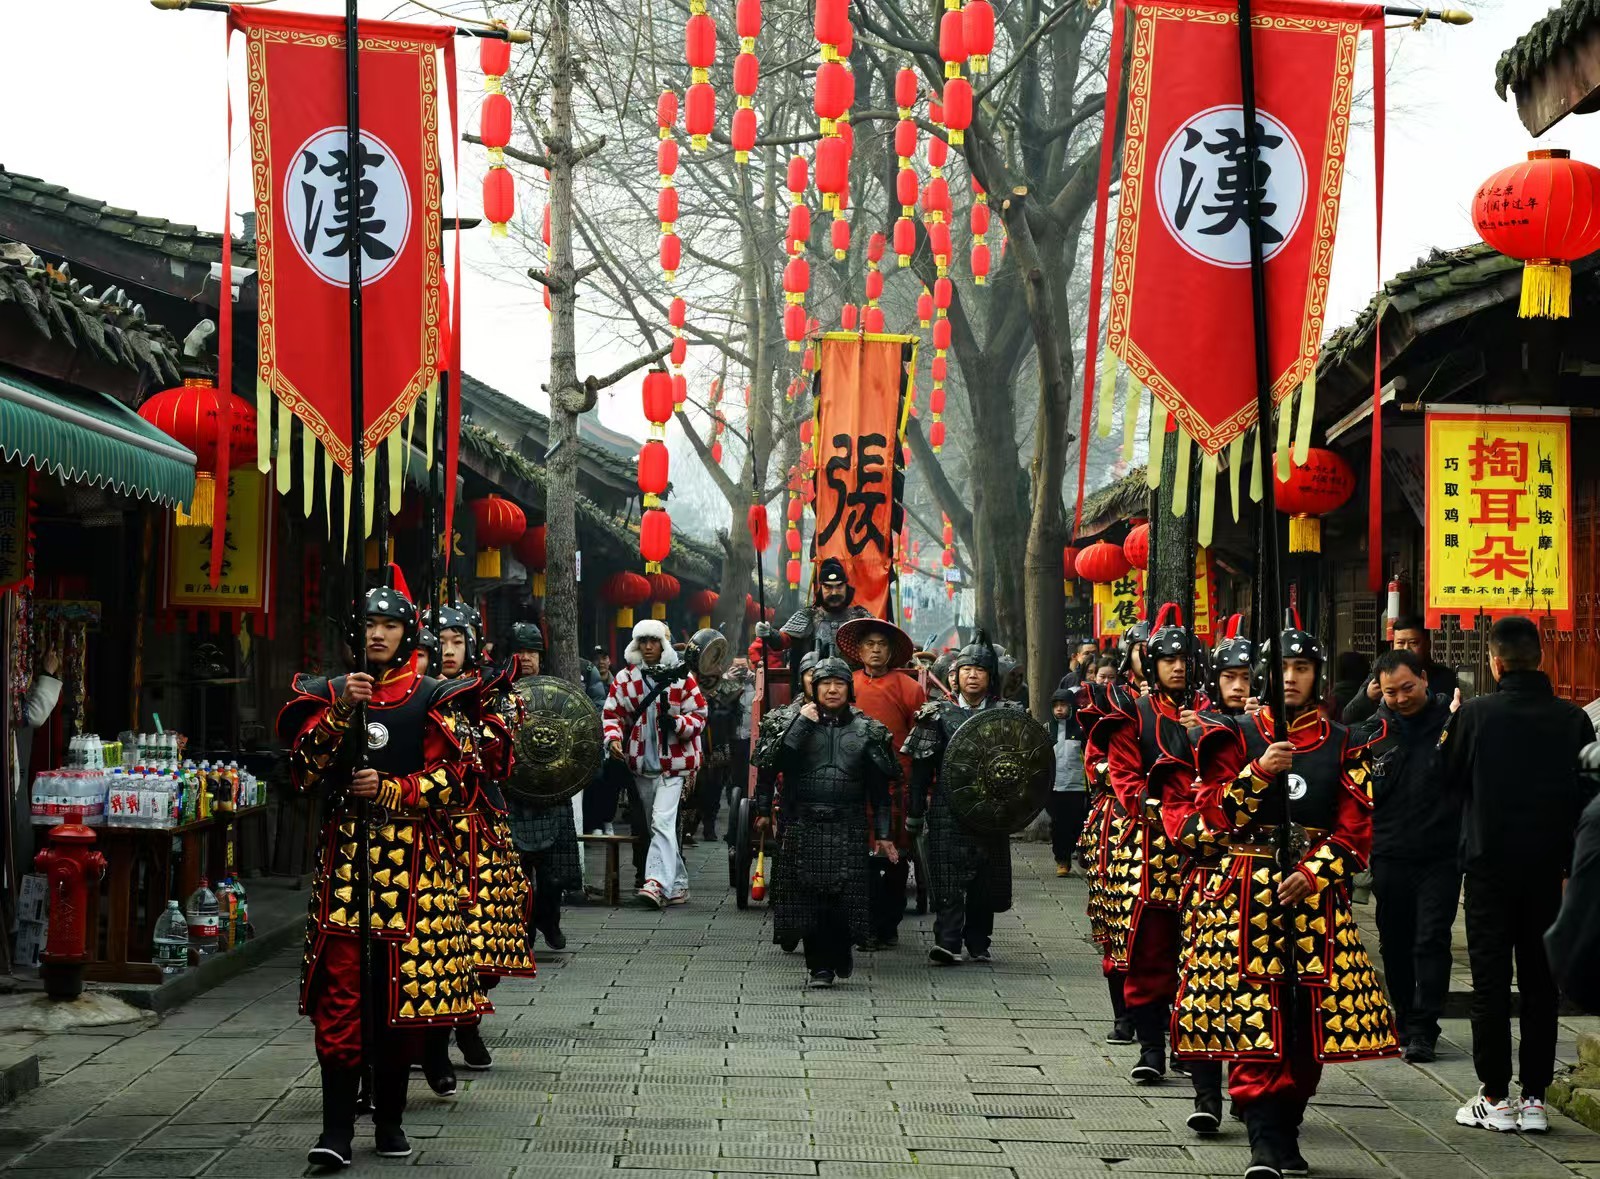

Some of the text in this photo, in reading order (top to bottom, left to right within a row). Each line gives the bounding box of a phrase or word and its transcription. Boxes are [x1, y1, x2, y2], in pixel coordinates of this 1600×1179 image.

[301, 143, 395, 260] 漢
[1175, 122, 1284, 243] 漢
[818, 433, 888, 556] 張
[1444, 458, 1459, 548] 巧取鸡眼
[1468, 437, 1530, 580] 掏耳朵
[1538, 459, 1553, 550] 肩颈按摩
[1113, 575, 1139, 626] 出售
[1443, 586, 1554, 596] 酒香不怕巷子深
